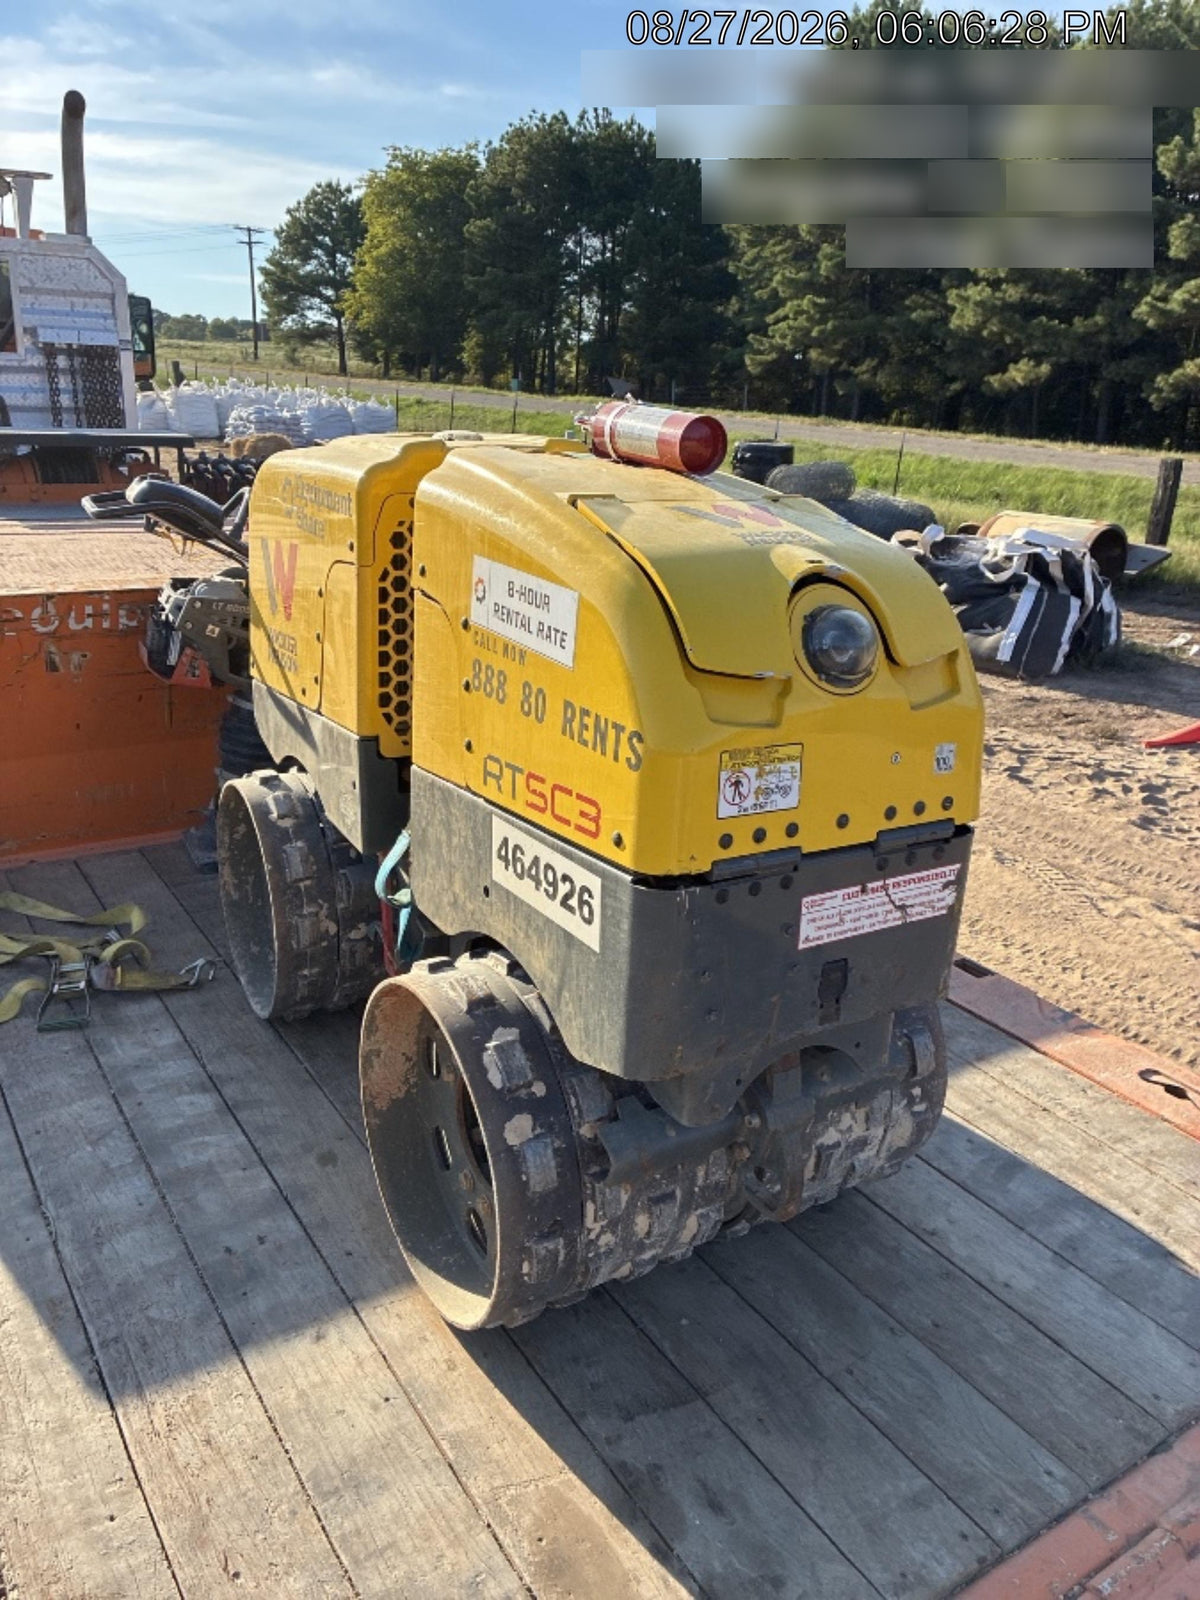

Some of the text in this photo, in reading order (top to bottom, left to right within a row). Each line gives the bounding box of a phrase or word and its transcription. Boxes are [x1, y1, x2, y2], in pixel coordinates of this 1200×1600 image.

[493, 602, 568, 650] RENTAL RATE
[507, 580, 550, 613] 8-HOUR
[472, 630, 498, 655] CALL
[471, 658, 644, 773] 888 80 RENTS
[482, 754, 602, 840] RTSC3
[496, 836, 595, 926] 464926
